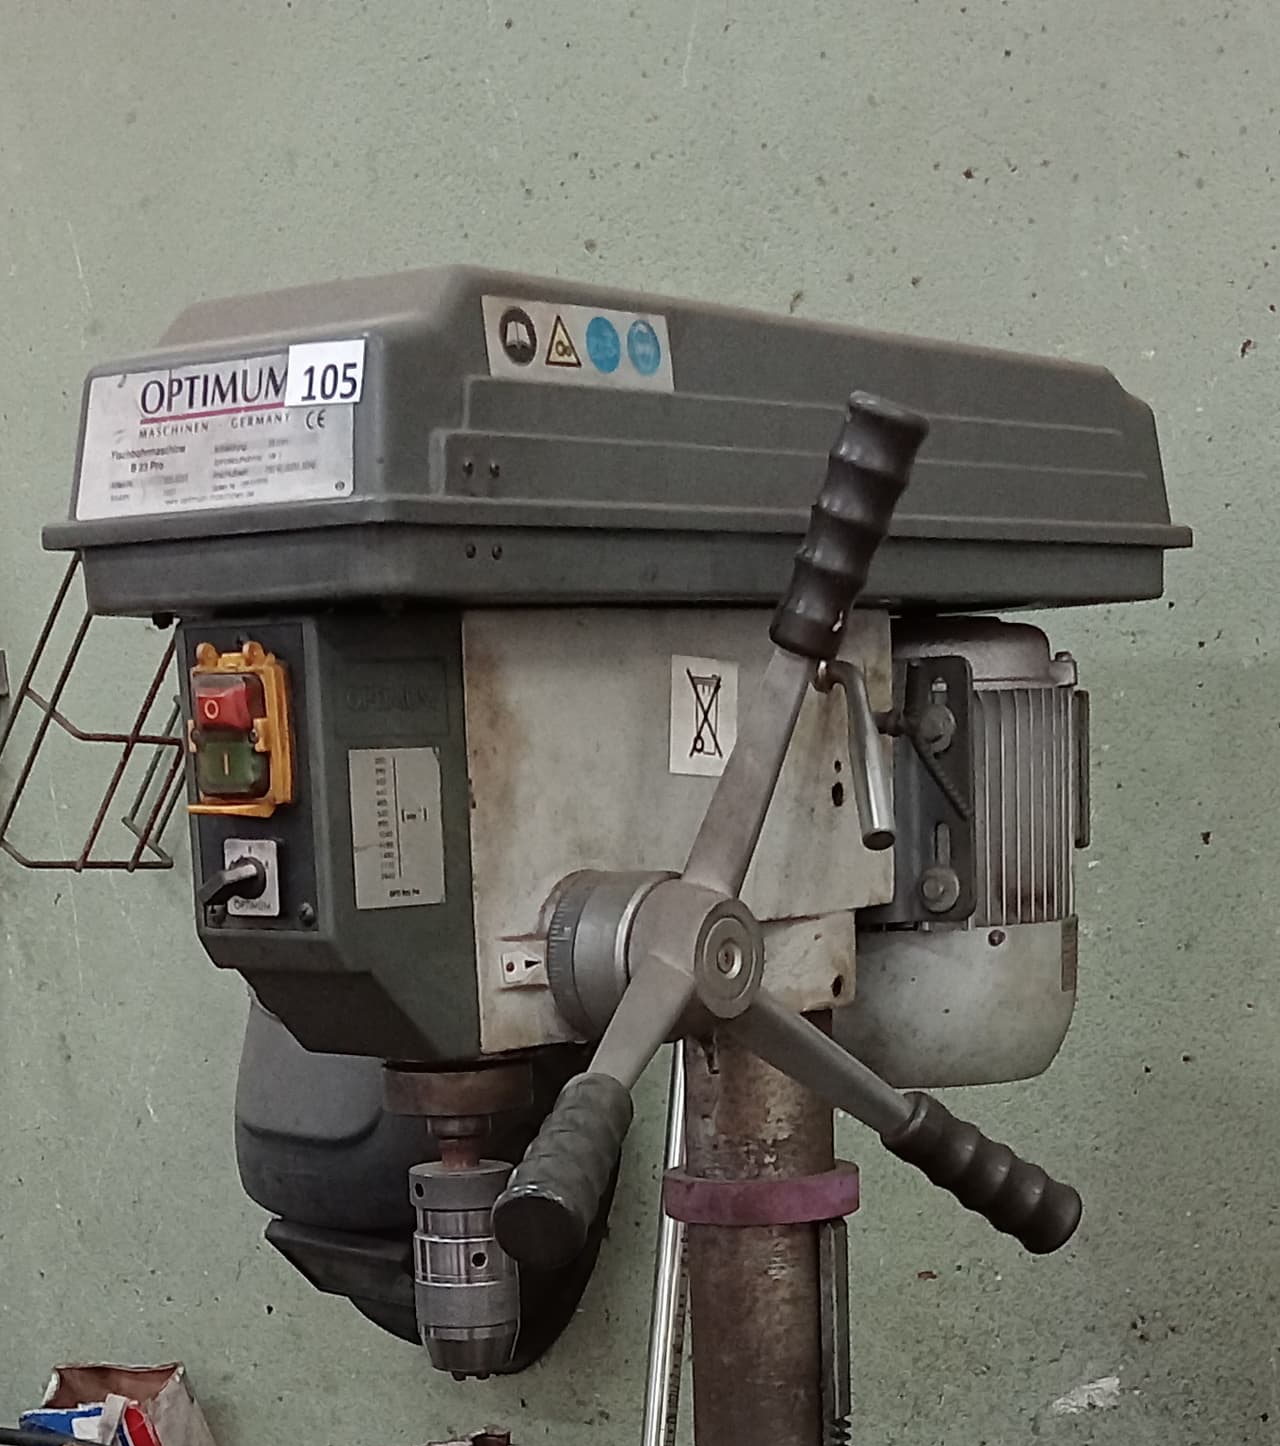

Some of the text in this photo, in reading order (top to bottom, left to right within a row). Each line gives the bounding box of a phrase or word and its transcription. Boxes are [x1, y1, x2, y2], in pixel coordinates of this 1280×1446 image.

[140, 365, 289, 415] OPTIMUM
[301, 362, 358, 402] 105
[138, 413, 291, 439] MASCHINEN GERMANY
